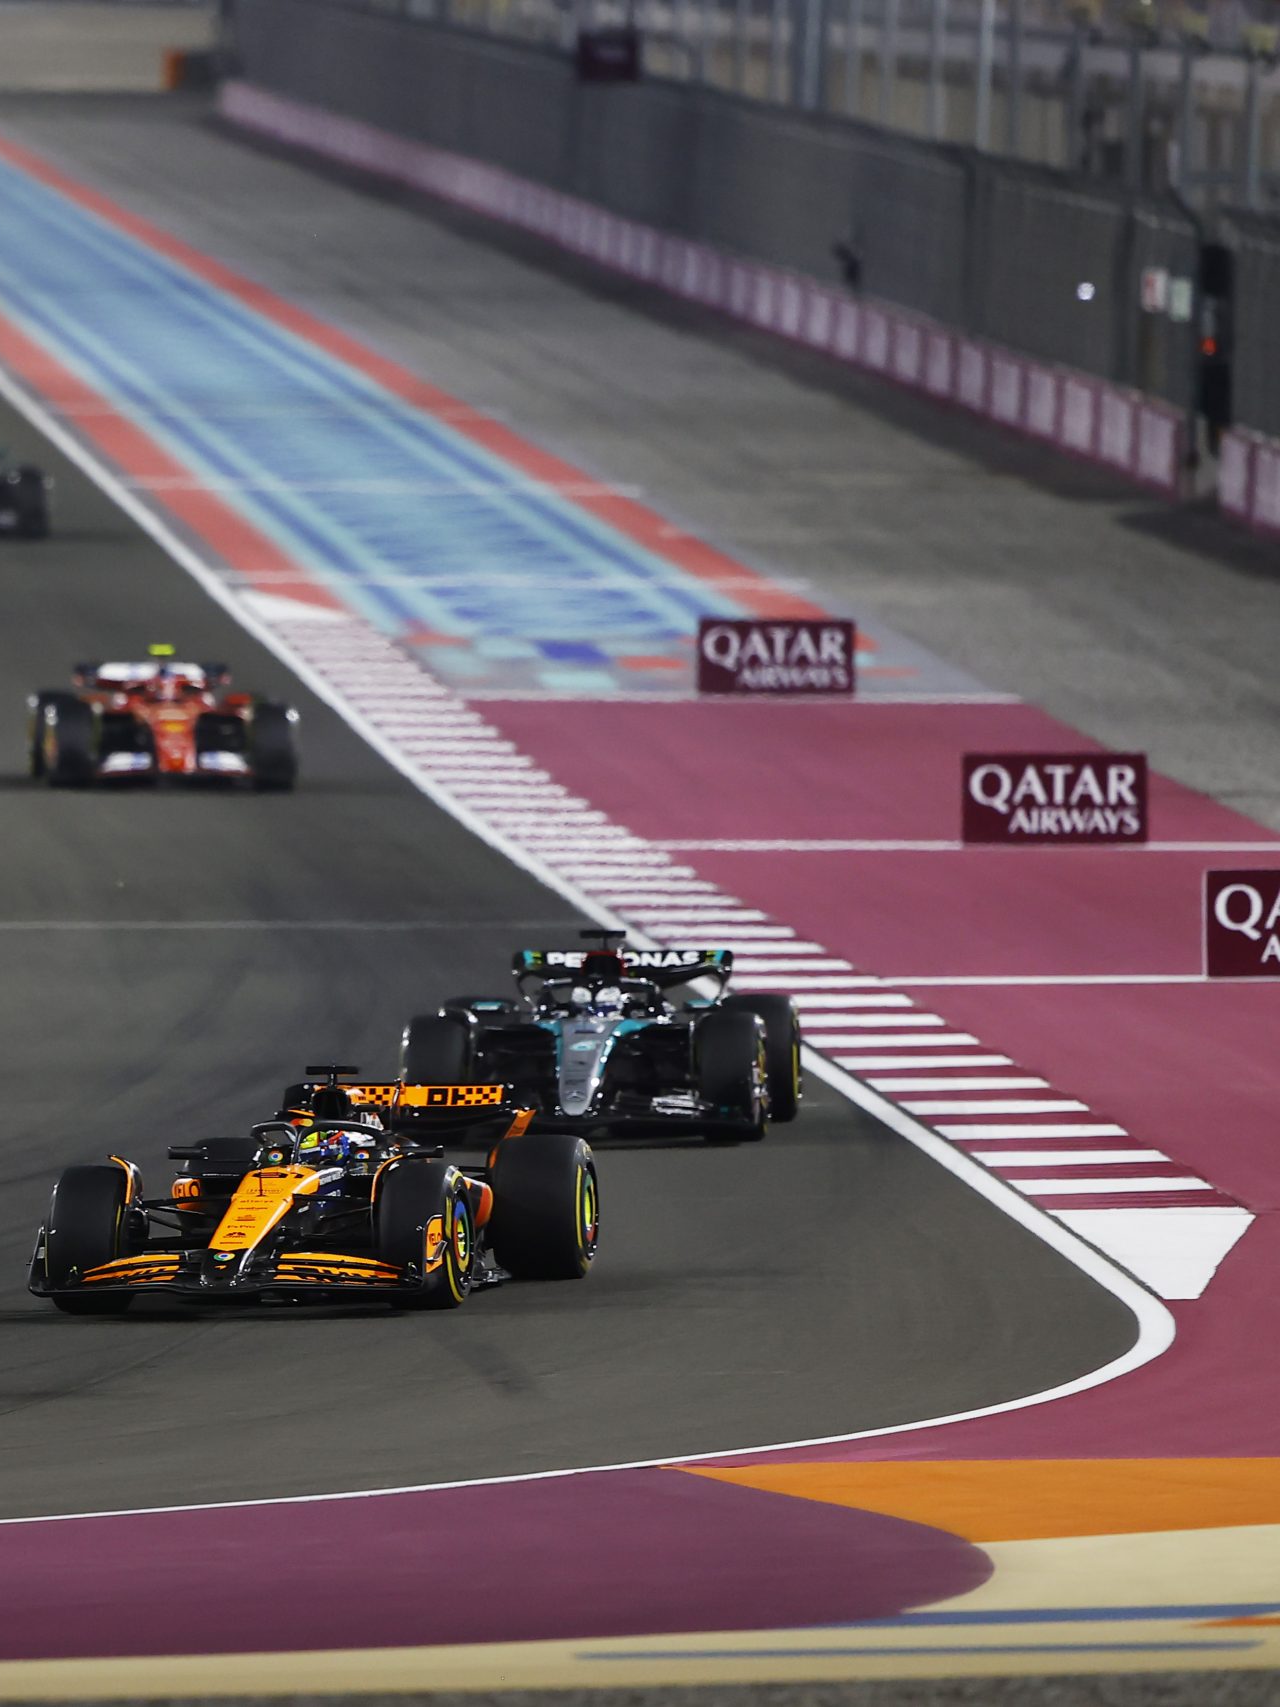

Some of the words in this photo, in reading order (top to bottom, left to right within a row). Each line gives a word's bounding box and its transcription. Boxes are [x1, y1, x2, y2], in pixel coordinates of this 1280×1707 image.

[703, 625, 846, 671] QATAR
[738, 667, 848, 688] AIRWAYS
[970, 763, 1136, 814] QATAR
[1008, 807, 1140, 834] AIRWAYS
[546, 952, 700, 968] PEONAS
